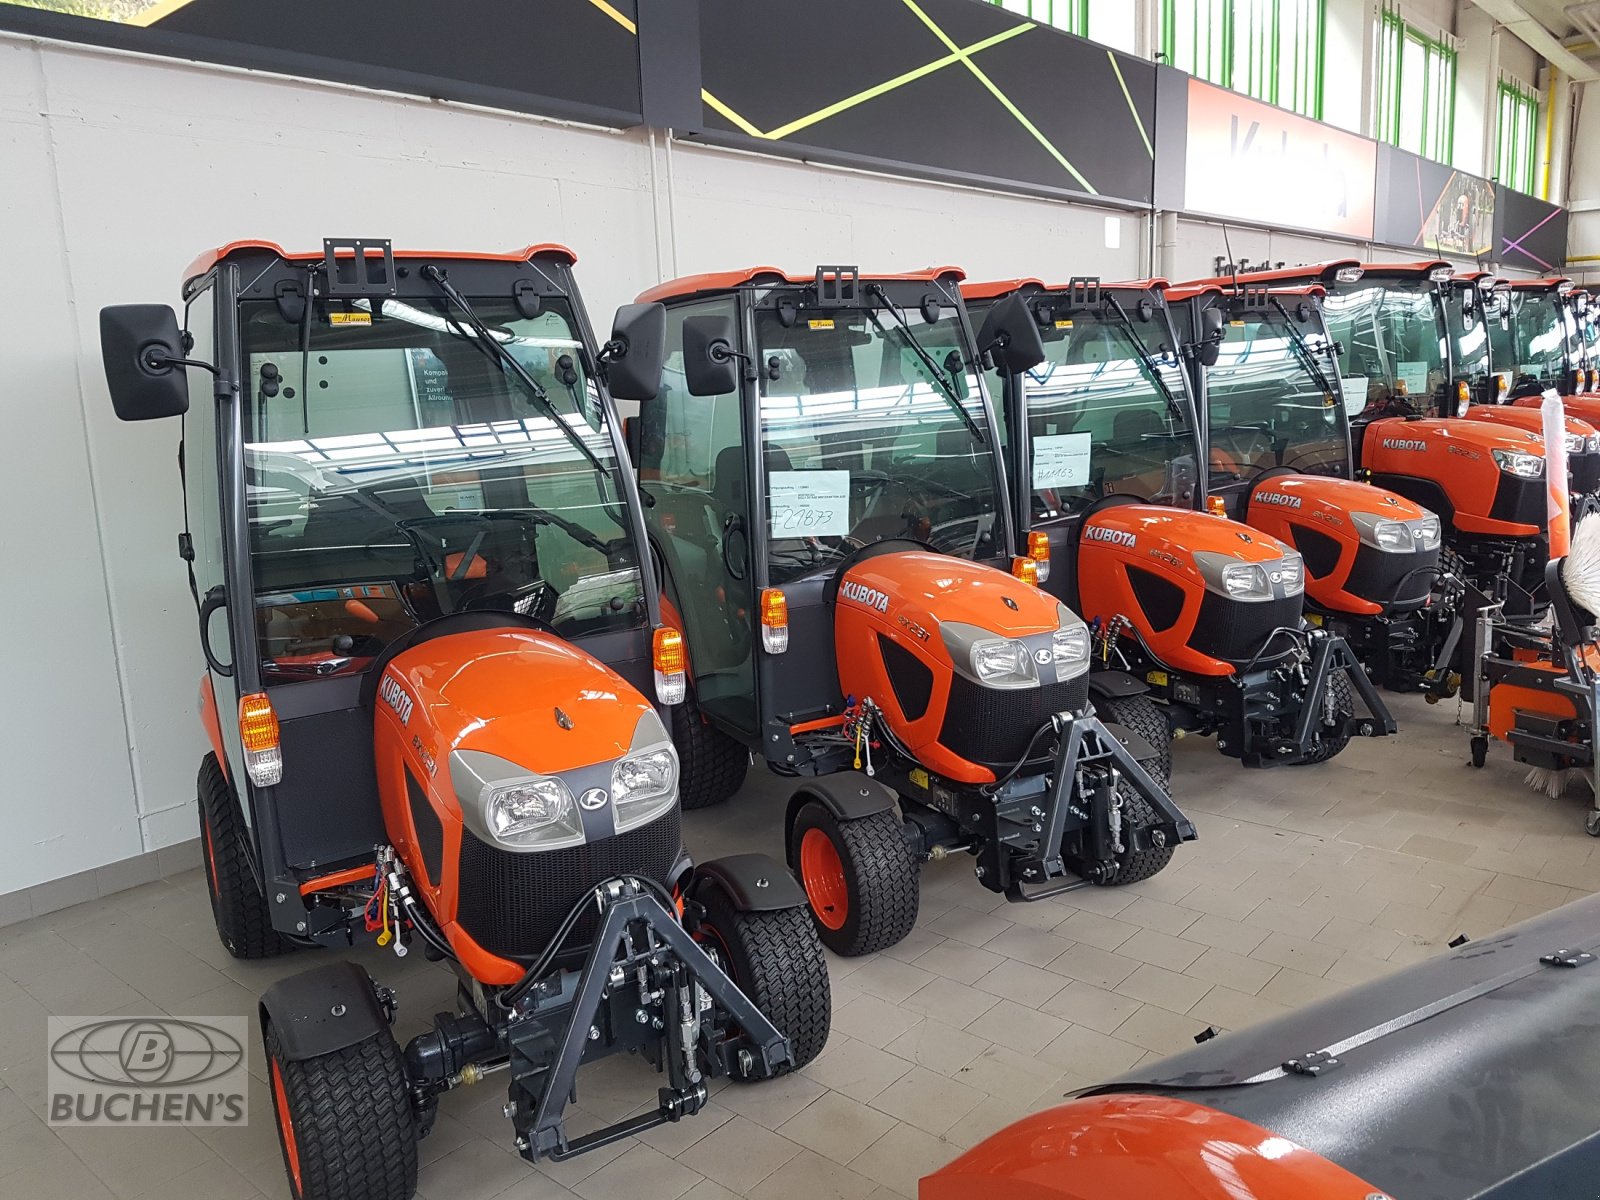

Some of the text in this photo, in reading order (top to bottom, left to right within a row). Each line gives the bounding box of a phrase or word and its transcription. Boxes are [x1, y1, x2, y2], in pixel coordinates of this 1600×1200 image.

[1382, 438, 1427, 451] KUBOTA
[1255, 491, 1302, 509] KUBOTA
[1085, 525, 1137, 548] KUBOTA
[842, 581, 889, 613] KUBOTA
[380, 674, 414, 727] KUBOTA
